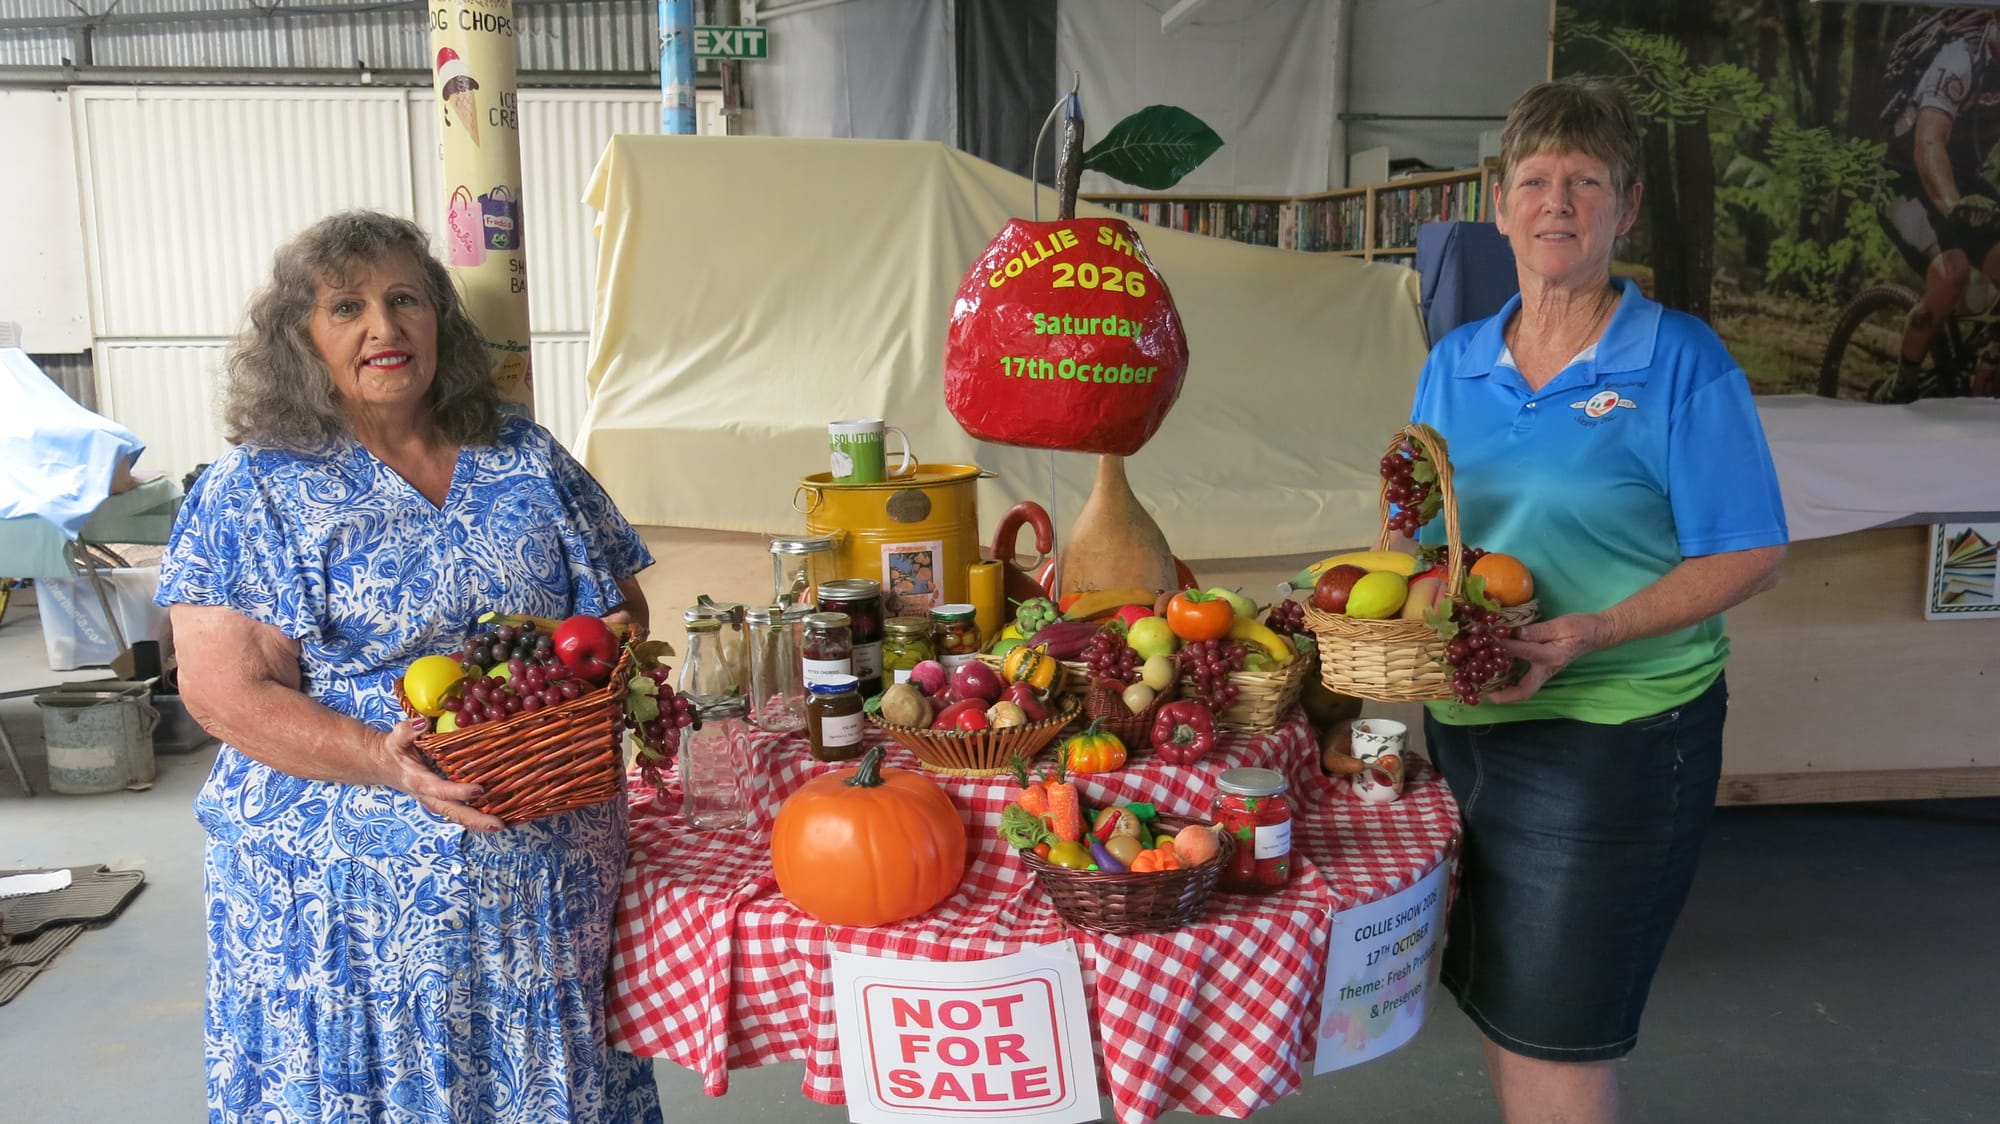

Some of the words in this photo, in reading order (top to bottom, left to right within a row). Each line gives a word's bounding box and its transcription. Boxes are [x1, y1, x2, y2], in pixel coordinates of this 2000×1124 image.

[429, 8, 448, 32] OG
[459, 8, 513, 38] CHOPS
[693, 30, 764, 56] EXIT
[489, 107, 519, 130] CRE
[988, 228, 1080, 289] COLLIE
[1052, 262, 1147, 298] 2026
[1033, 313, 1144, 342] Saturday
[999, 355, 1054, 381] 17th
[1058, 358, 1158, 385] October
[1354, 917, 1393, 942] COLLIE
[1395, 902, 1422, 929] SHOW
[1366, 943, 1391, 967] 17TH
[1392, 922, 1429, 956] OCTOBER
[1339, 978, 1385, 1001] Theme:
[1387, 960, 1411, 985] Fresh
[891, 993, 1024, 1031] NOT
[1370, 1004, 1379, 1019] &
[1382, 982, 1422, 1014] Preserves
[899, 1033, 1030, 1067] FOR
[888, 1066, 1051, 1102] SALE
